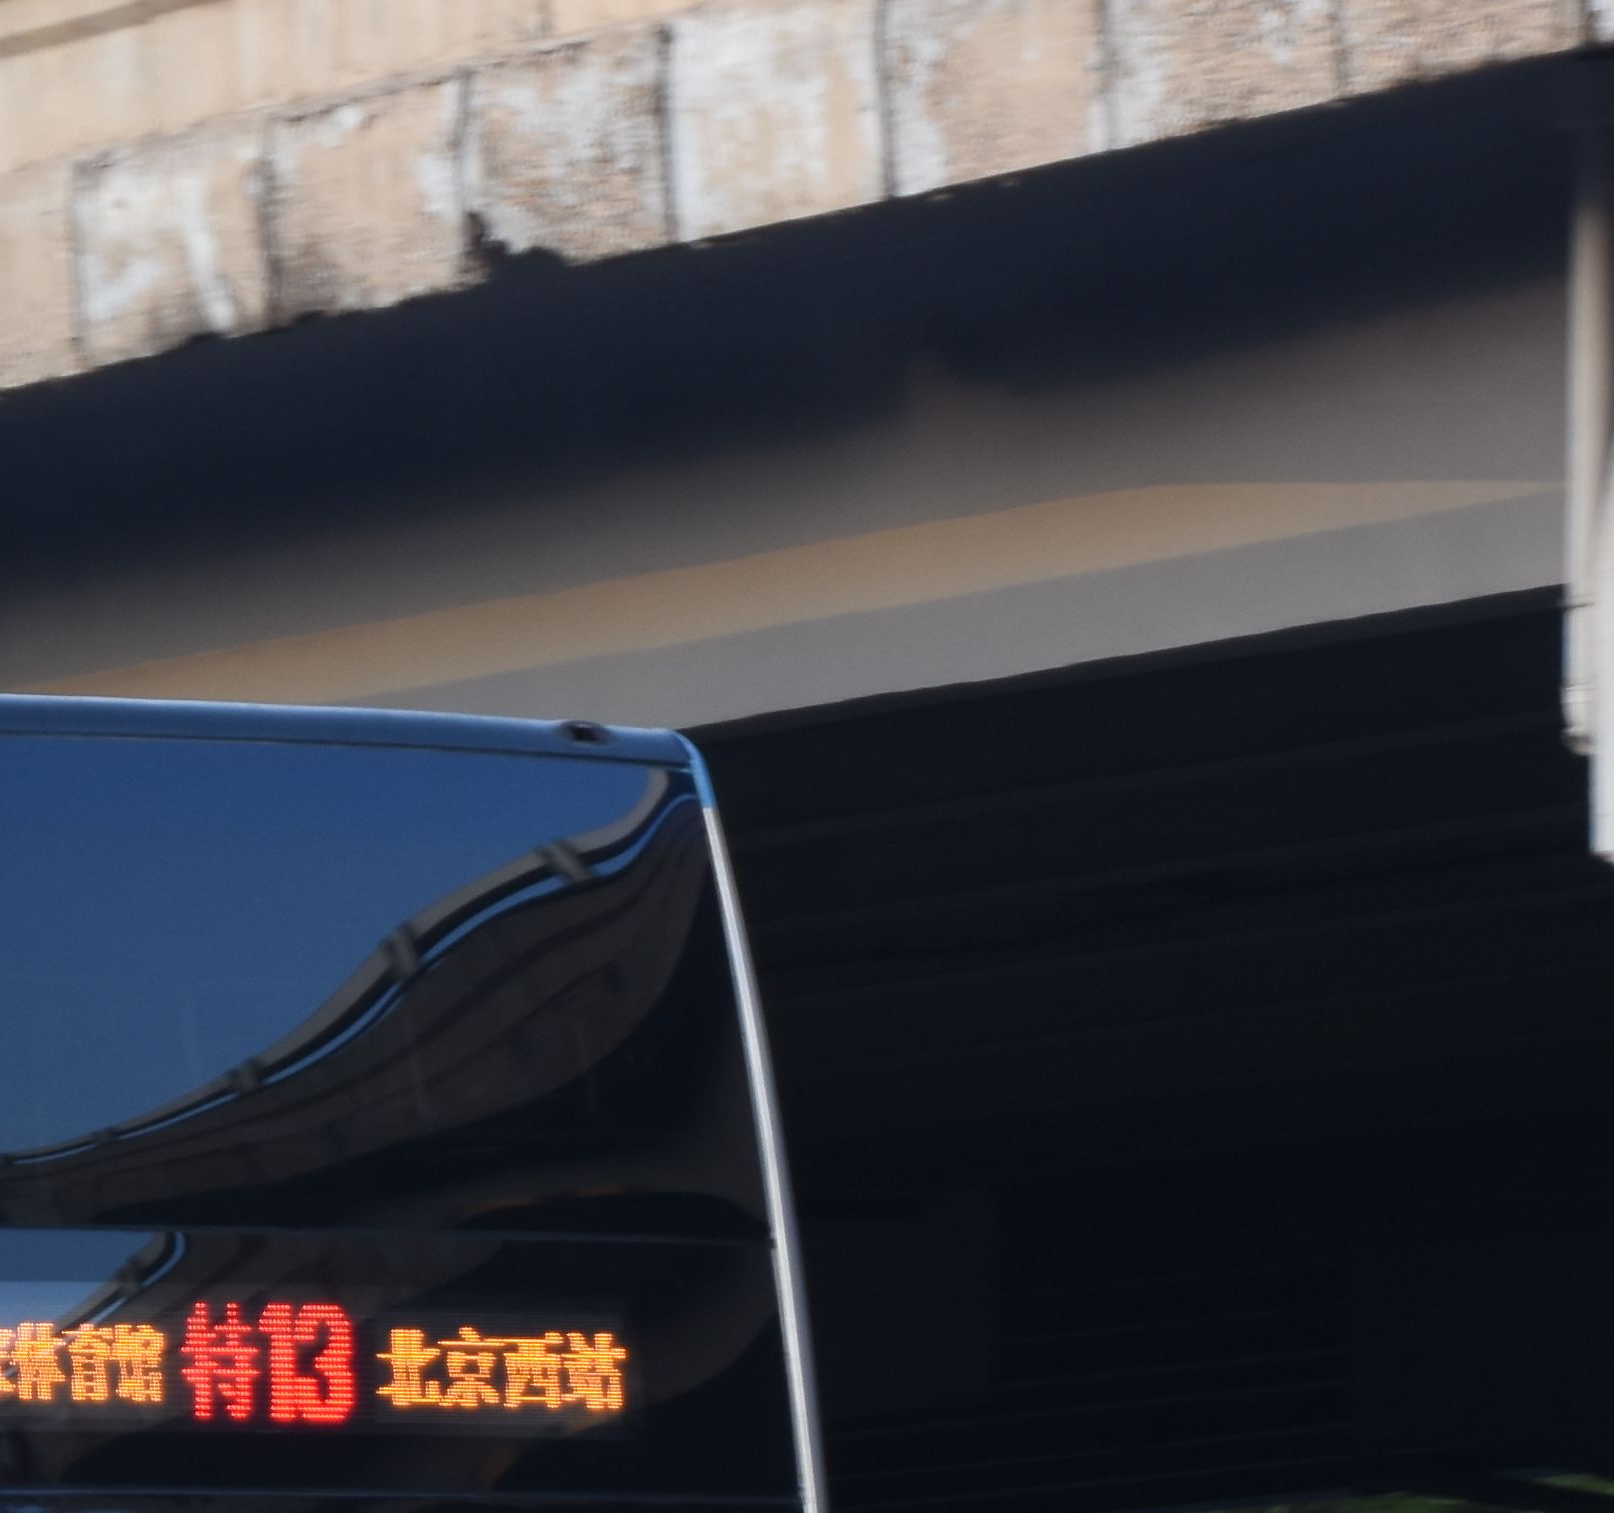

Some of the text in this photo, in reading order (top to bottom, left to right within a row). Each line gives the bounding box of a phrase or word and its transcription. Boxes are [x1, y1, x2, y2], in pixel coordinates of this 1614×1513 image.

[180, 1301, 356, 1421] 特13
[376, 1326, 627, 1409] 北京西站
